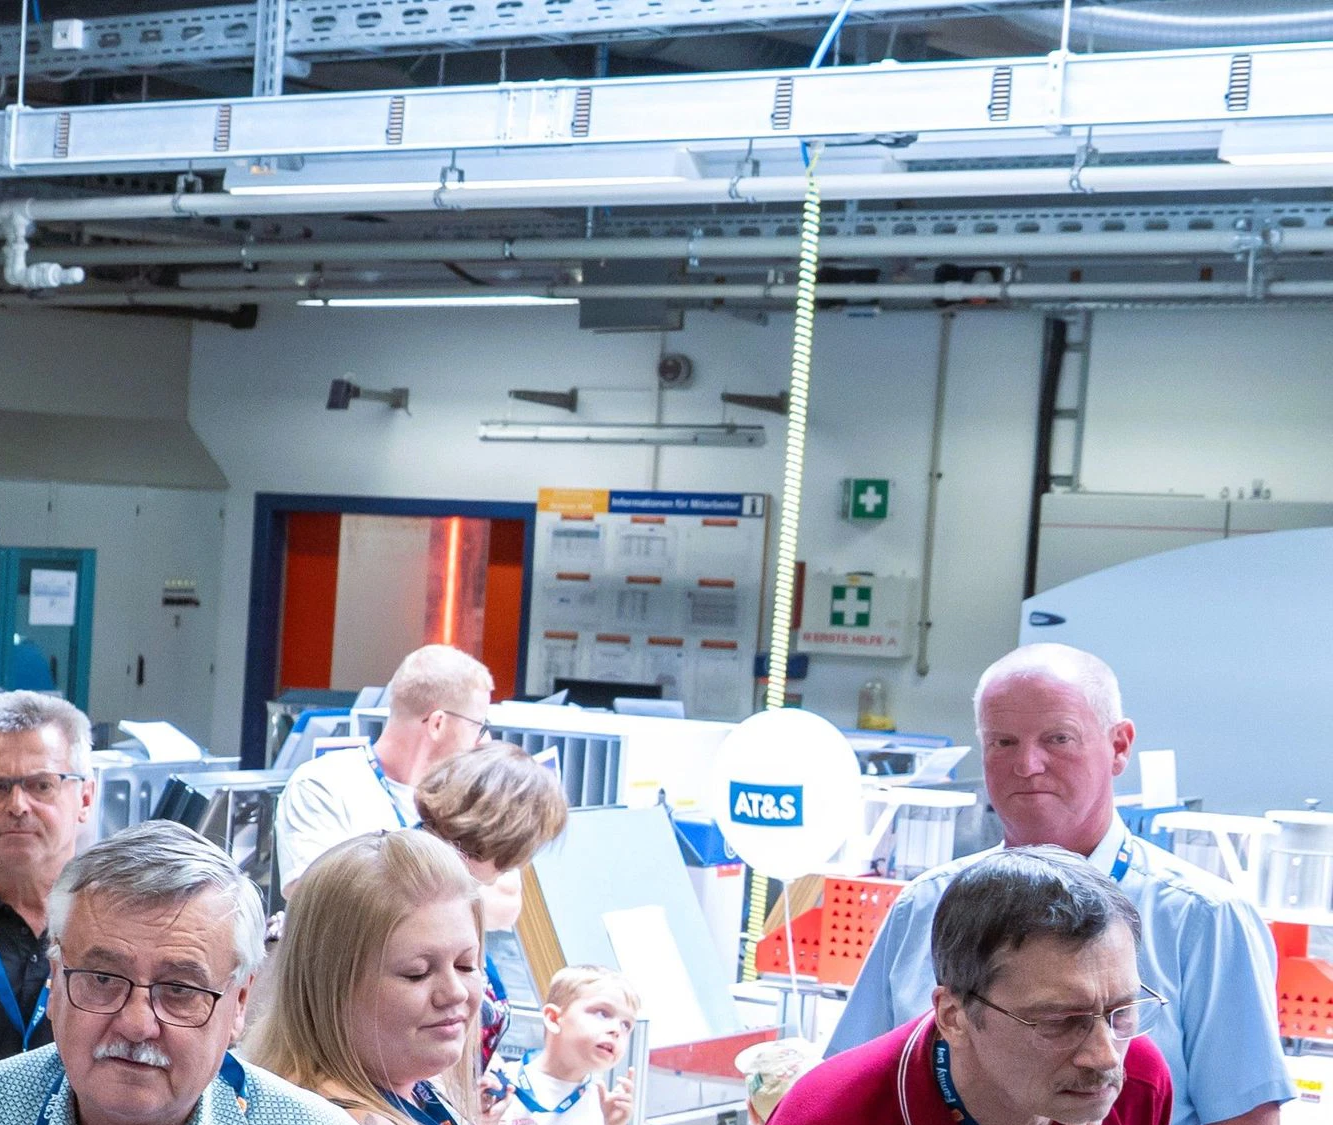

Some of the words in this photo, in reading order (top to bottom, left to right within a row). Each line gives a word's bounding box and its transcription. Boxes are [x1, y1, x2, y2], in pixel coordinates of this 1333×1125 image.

[611, 496, 674, 509] Informationen
[675, 498, 689, 510] für
[690, 498, 740, 511] Mitarbeiter
[734, 791, 796, 820] AT&S
[936, 1066, 957, 1104] Family
